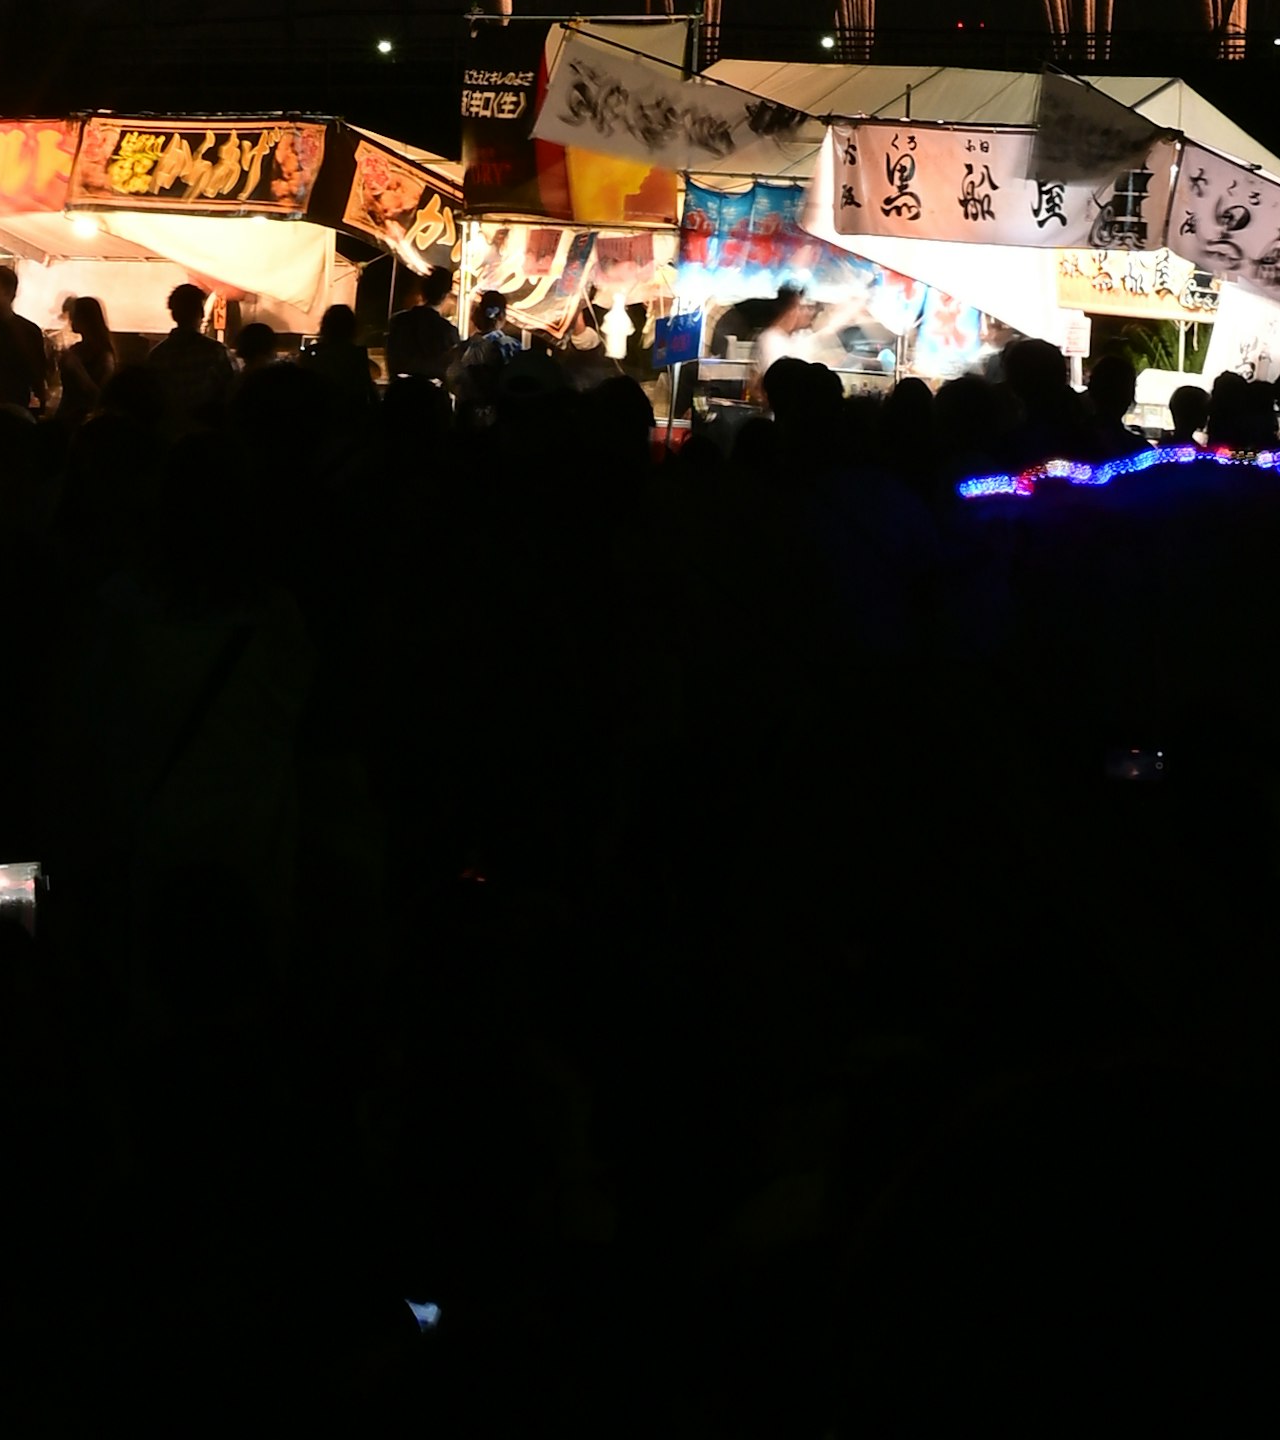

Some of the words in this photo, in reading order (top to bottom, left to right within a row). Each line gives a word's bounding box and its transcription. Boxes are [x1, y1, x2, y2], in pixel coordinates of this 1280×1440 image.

[149, 127, 280, 203] からあげ
[891, 134, 918, 151] くろ
